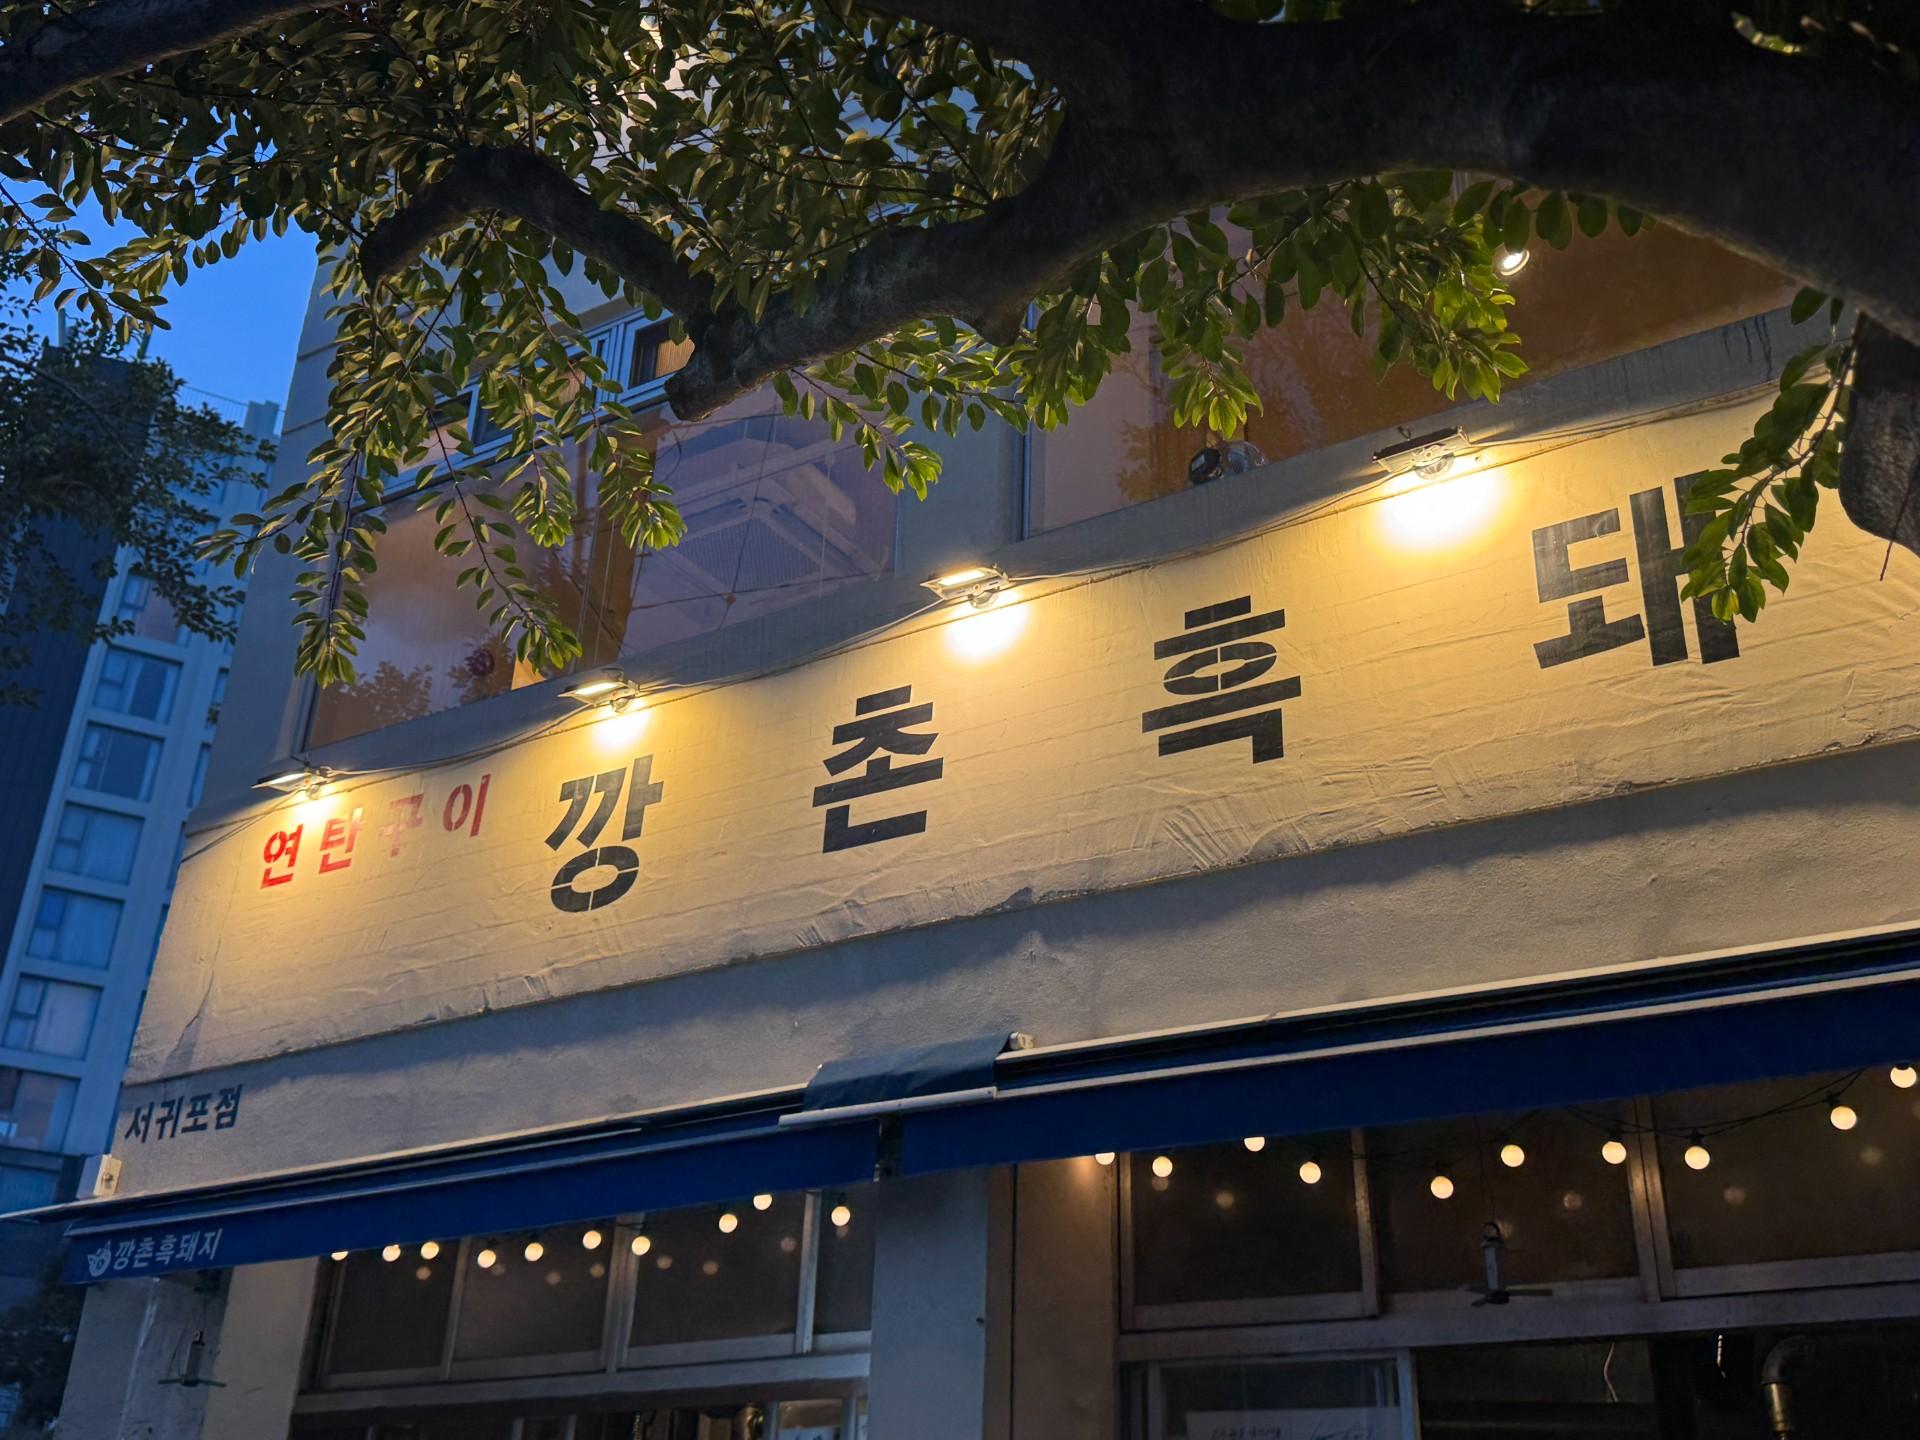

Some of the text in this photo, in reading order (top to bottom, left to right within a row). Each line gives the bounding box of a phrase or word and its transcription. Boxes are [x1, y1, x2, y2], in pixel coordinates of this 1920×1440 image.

[260, 773, 491, 889] 연탄구이
[124, 1084, 243, 1143] 서귀포점
[113, 1228, 223, 1270] 깡촌흑돼지
